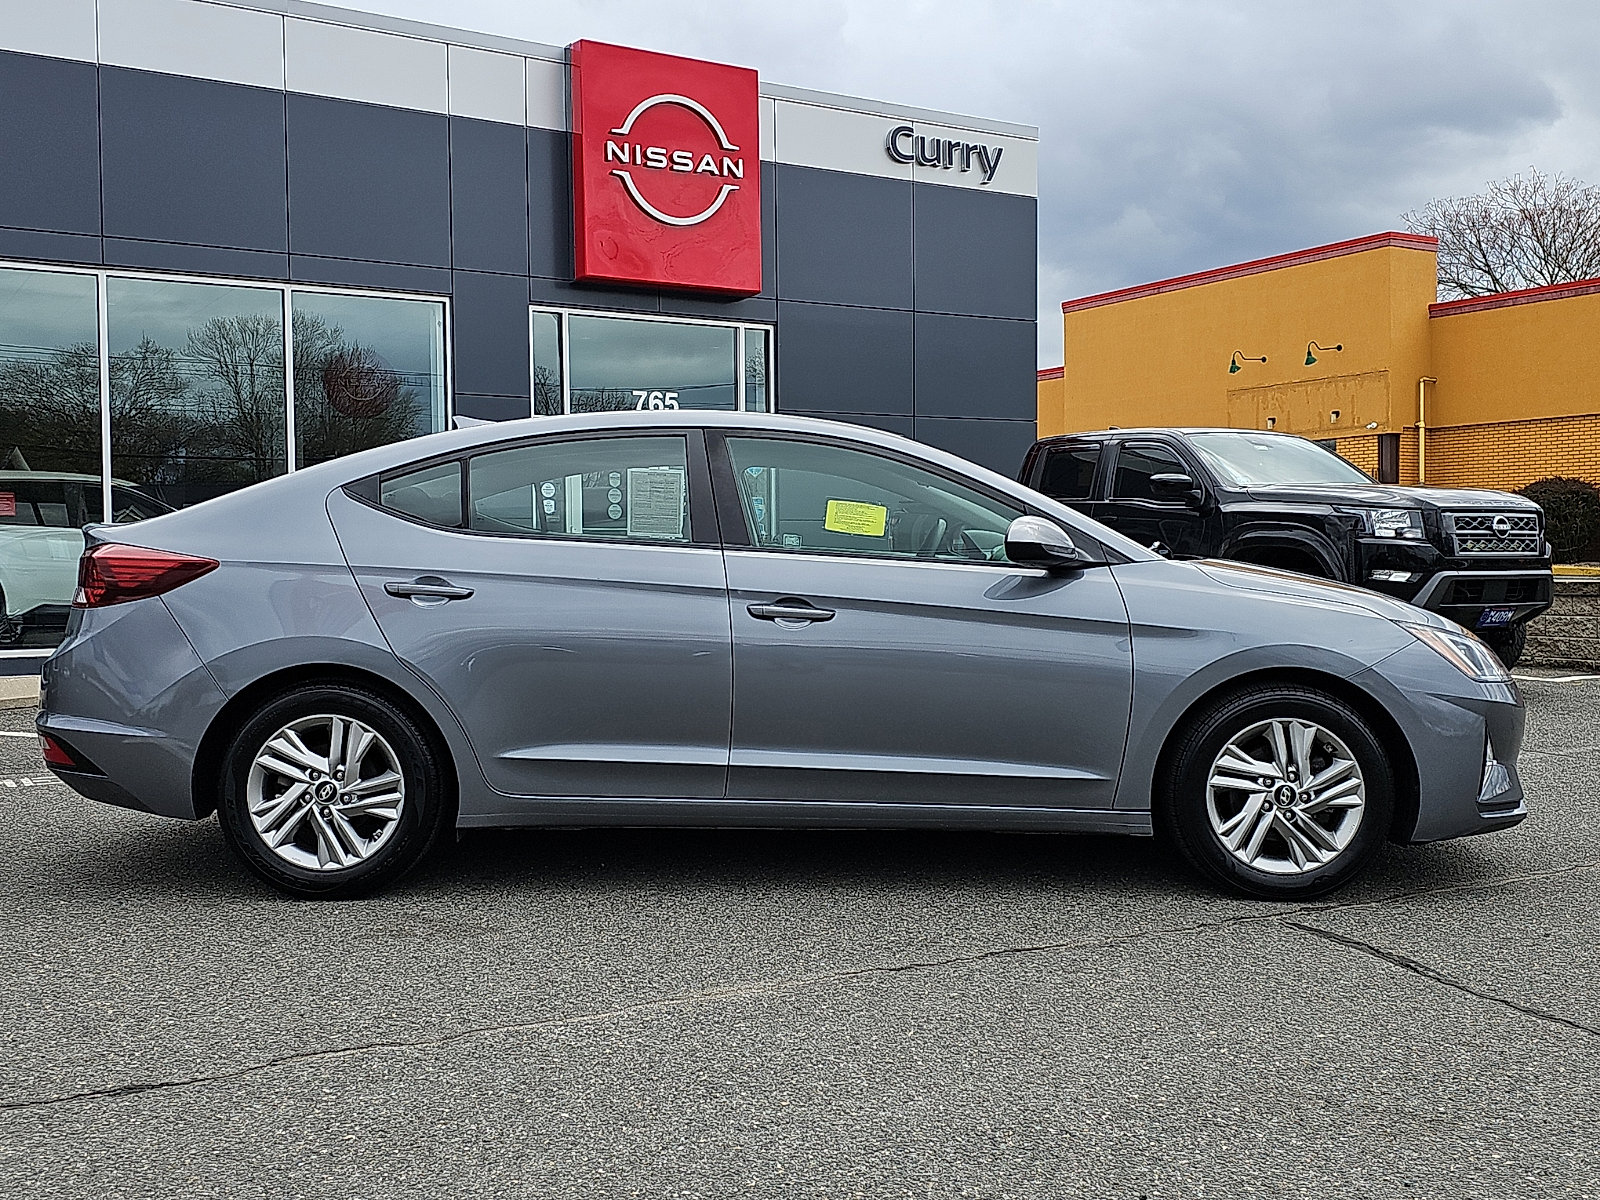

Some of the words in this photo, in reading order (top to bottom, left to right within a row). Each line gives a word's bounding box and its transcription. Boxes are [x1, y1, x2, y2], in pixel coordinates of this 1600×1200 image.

[604, 140, 744, 179] NISSAN
[885, 125, 1004, 185] Curry
[632, 390, 680, 411] 765
